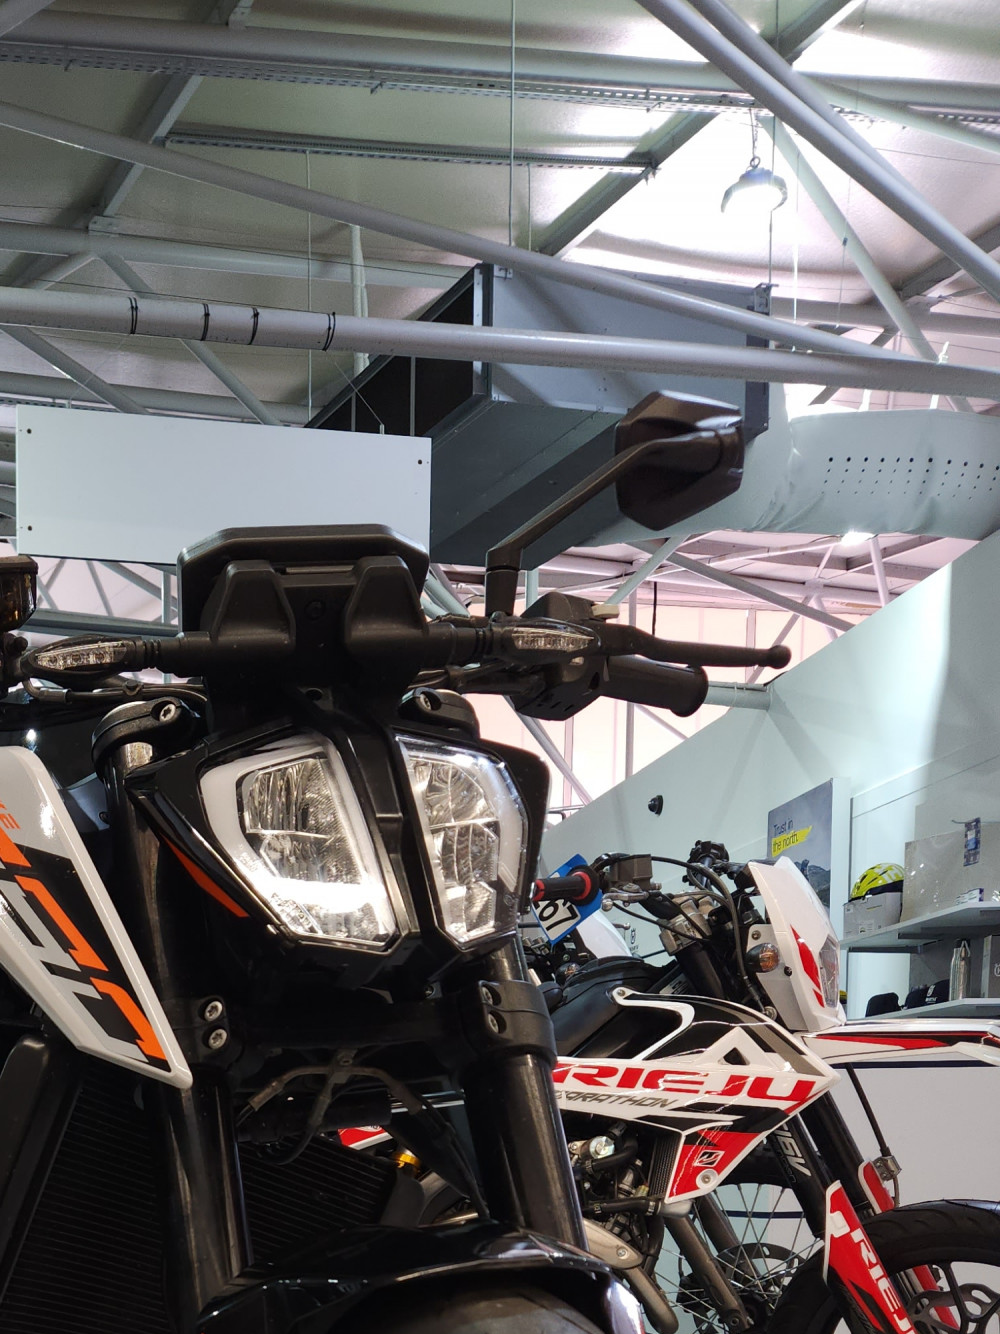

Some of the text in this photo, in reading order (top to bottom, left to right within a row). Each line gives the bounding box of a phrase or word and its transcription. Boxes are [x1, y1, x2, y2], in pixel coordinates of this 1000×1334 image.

[773, 817, 794, 836] Trust in
[772, 838, 782, 853] the
[553, 1062, 816, 1103] RIEJU
